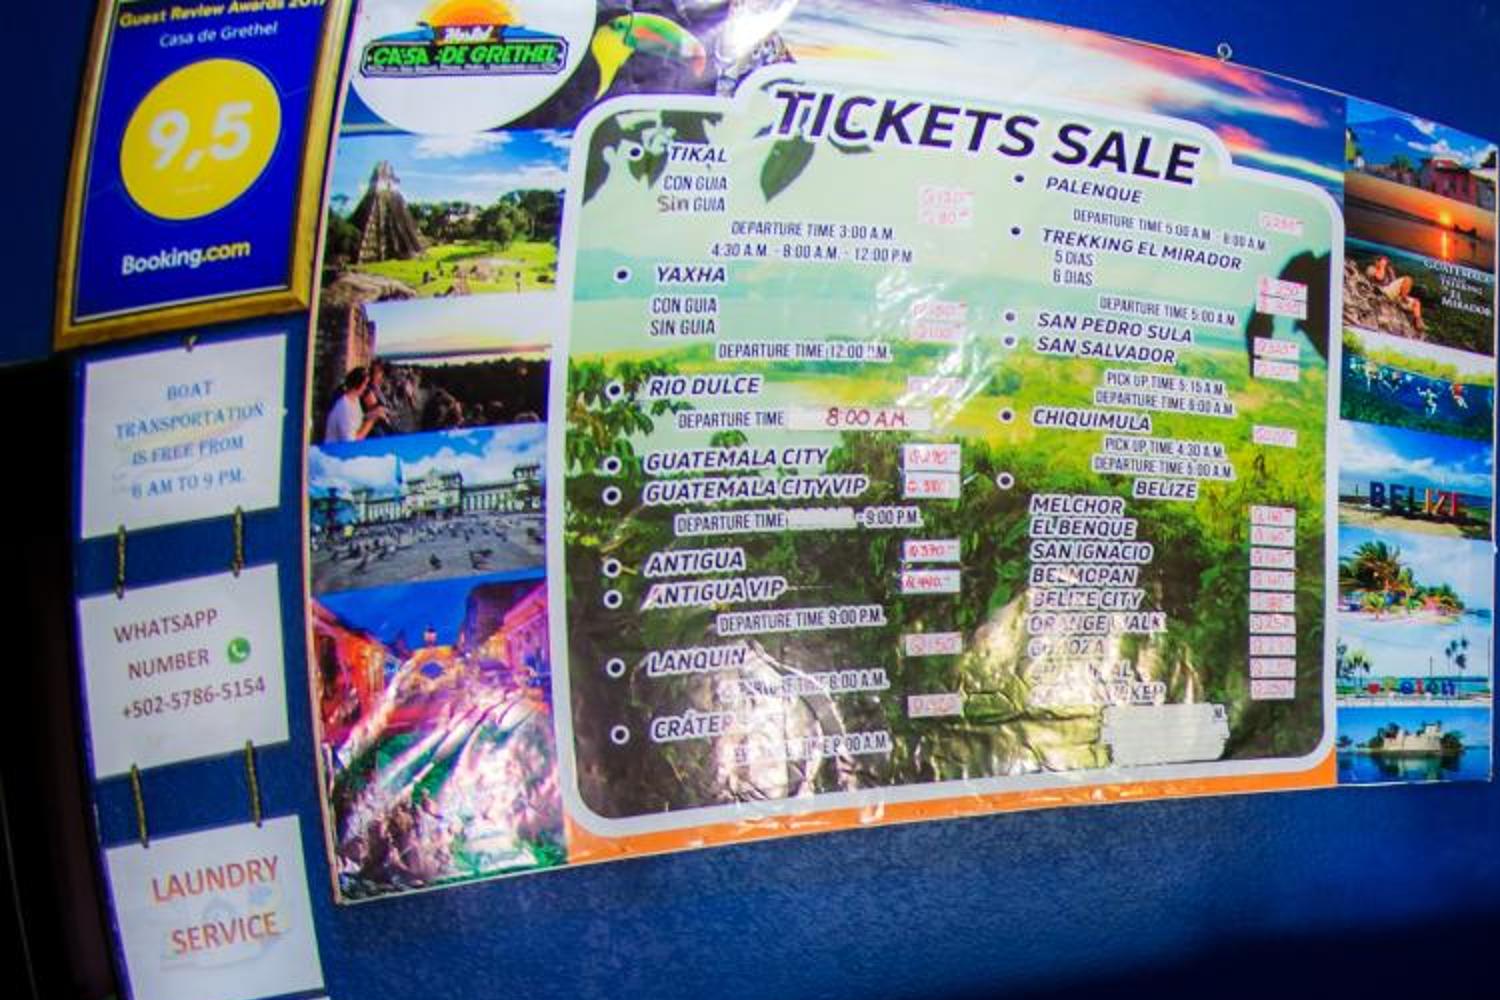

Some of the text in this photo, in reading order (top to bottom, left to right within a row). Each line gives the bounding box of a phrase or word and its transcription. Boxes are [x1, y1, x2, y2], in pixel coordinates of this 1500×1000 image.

[120, 11, 165, 27] Guest
[171, 4, 225, 21] Review
[160, 21, 279, 48] Casa de Grethel
[373, 45, 557, 65] CASA DE GRETHEL
[773, 88, 1201, 186] TICKETS SALE
[670, 145, 728, 164] TIKAL
[663, 175, 728, 191] CON GUIA
[1045, 176, 1143, 205] PALENQUE
[657, 195, 689, 213] Sin
[693, 196, 725, 212] GUIA
[731, 220, 867, 240] DEPARTURE TIME 3:00
[1073, 208, 1162, 233] DEPARTURE TIME
[121, 240, 250, 276] Booking.com
[712, 242, 741, 258] 4:30
[854, 246, 890, 262] 12:00
[1042, 228, 1243, 271] TREKKING EL MIRADOR
[1055, 249, 1094, 267] 5 DIAS
[656, 266, 727, 284] YAXHA
[1053, 269, 1094, 287] 6 DIAS
[652, 297, 717, 315] CON GUIA
[1101, 297, 1161, 318] DEPARTURE
[1165, 306, 1188, 320] TIME
[650, 319, 716, 336] SIN GUIA
[1038, 312, 1192, 344] SAN PEDRO SULA
[718, 343, 792, 360] DEPARTURE
[795, 343, 825, 359] TIME
[1037, 336, 1175, 364] SAN SALVADOR
[167, 379, 214, 401] BOAT
[650, 377, 761, 397] RIO DULCE
[1107, 371, 1131, 387] PICK
[1134, 373, 1149, 387] UP
[1151, 375, 1176, 390] TIME
[1096, 390, 1186, 411] DEPARTURE TIME
[116, 400, 265, 438] TRANSPORTATION
[679, 410, 785, 429] DEPARTURE TIME
[825, 406, 870, 427] 8:00
[1033, 408, 1150, 431] CHIQUIMULA
[132, 436, 244, 465] IS FREE FROM
[1105, 437, 1129, 452] PICK
[1132, 439, 1147, 453] UP
[1150, 441, 1174, 456] TIME
[646, 448, 829, 471] GUATEMALA CITY
[1094, 456, 1155, 473] DEPARTURE
[1160, 460, 1184, 475] TIME
[147, 473, 213, 497] AM TO 9
[645, 476, 867, 503] GUATEMALA CITY VIP
[1135, 480, 1197, 498] BELIZE
[1032, 497, 1123, 515] MELCHOR
[1369, 480, 1462, 518] BELIZE
[677, 513, 751, 533] DEPARTURE
[755, 512, 785, 528] TIME
[866, 509, 894, 525] 9:00
[1032, 519, 1136, 538] EL BENQUE
[648, 551, 744, 575] ANTIGUA
[1032, 543, 1151, 562] SAN IGNACIO
[1032, 567, 1135, 584] BELMOPAN
[648, 579, 785, 605] ANTIGUA VIP
[1034, 591, 1143, 608] BELIZE CITY
[113, 608, 219, 645] WHATSAPP
[720, 613, 793, 634] DEPARTURE
[796, 612, 825, 627] TIME
[829, 609, 857, 625] 9:00
[128, 647, 210, 681] NUMBER
[650, 648, 746, 673] LANQUIN
[121, 676, 266, 721] +502-5786-5154
[151, 856, 281, 904] LAUNDRY
[171, 912, 281, 956] SERVICE
